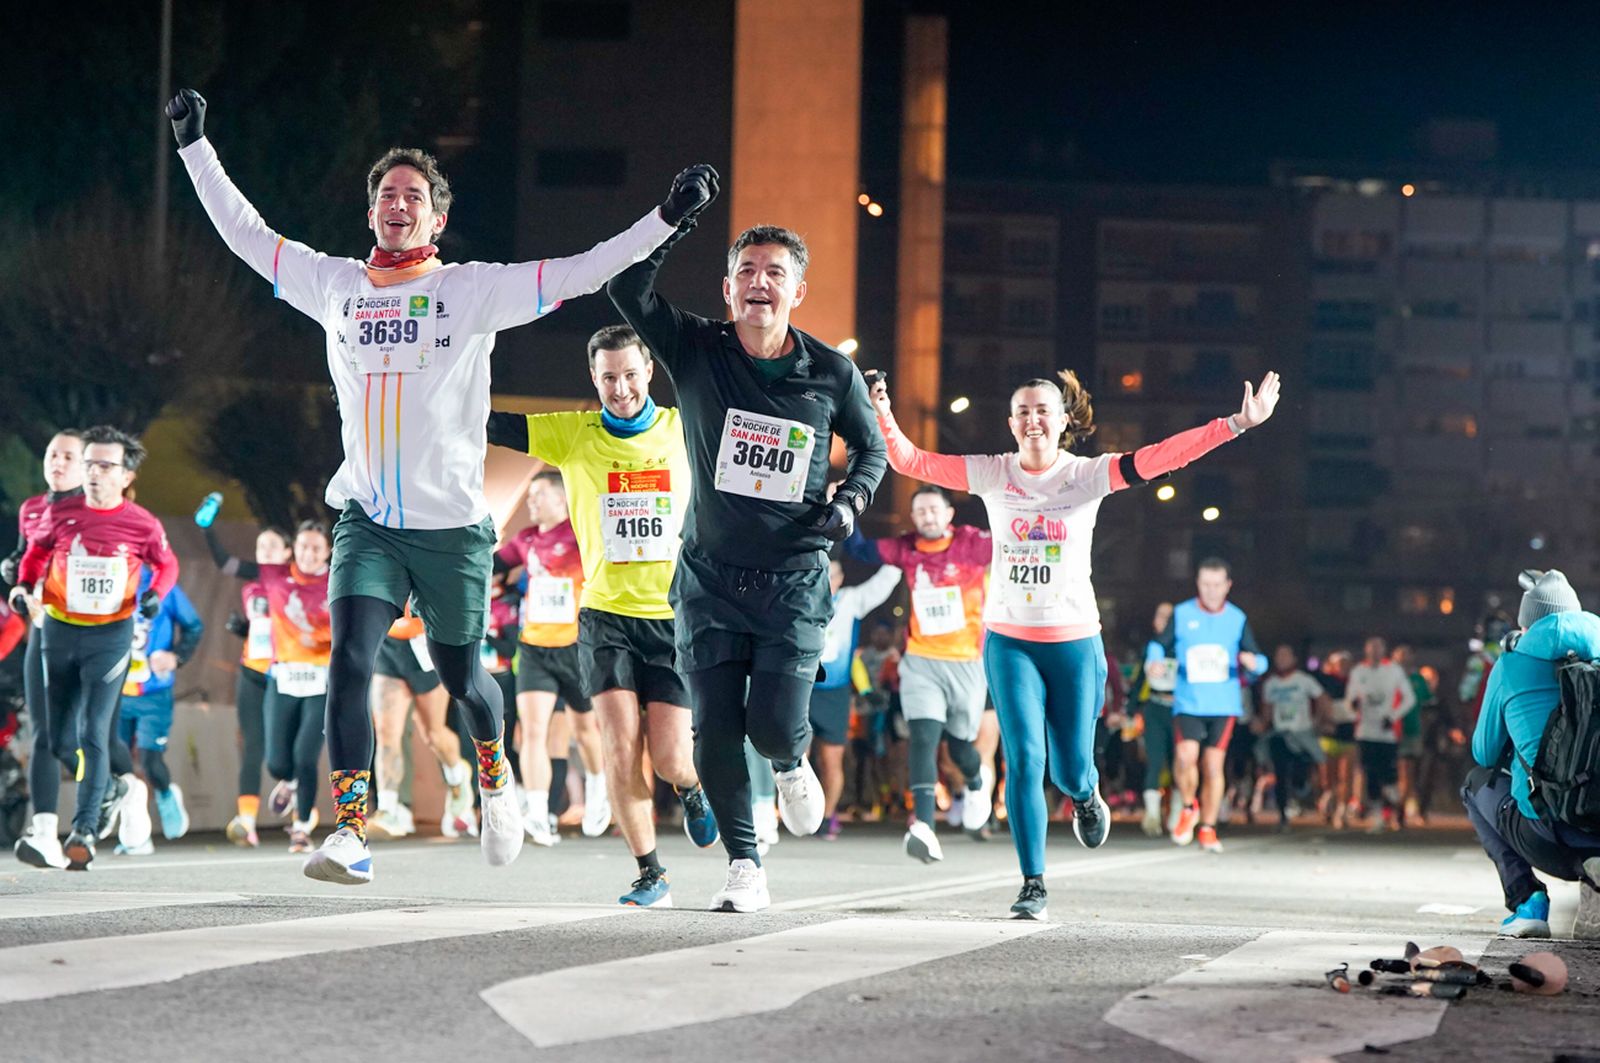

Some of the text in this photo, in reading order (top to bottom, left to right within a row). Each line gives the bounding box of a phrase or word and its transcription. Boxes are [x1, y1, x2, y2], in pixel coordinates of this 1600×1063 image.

[364, 300, 390, 309] NOCHE
[391, 299, 401, 308] DE
[355, 311, 372, 320] SAN
[373, 308, 400, 320] ANTÓN
[359, 319, 418, 345] 3639
[742, 421, 769, 434] NOCHE
[770, 427, 782, 436] DE
[730, 428, 749, 440] SAN
[749, 433, 781, 446] ANTÓN
[733, 441, 795, 474] 3640
[616, 500, 639, 508] NOCHE
[608, 508, 650, 517] SAN ANTÓN
[615, 517, 663, 538] 4166
[1009, 565, 1051, 584] 4210
[81, 578, 114, 594] 1813
